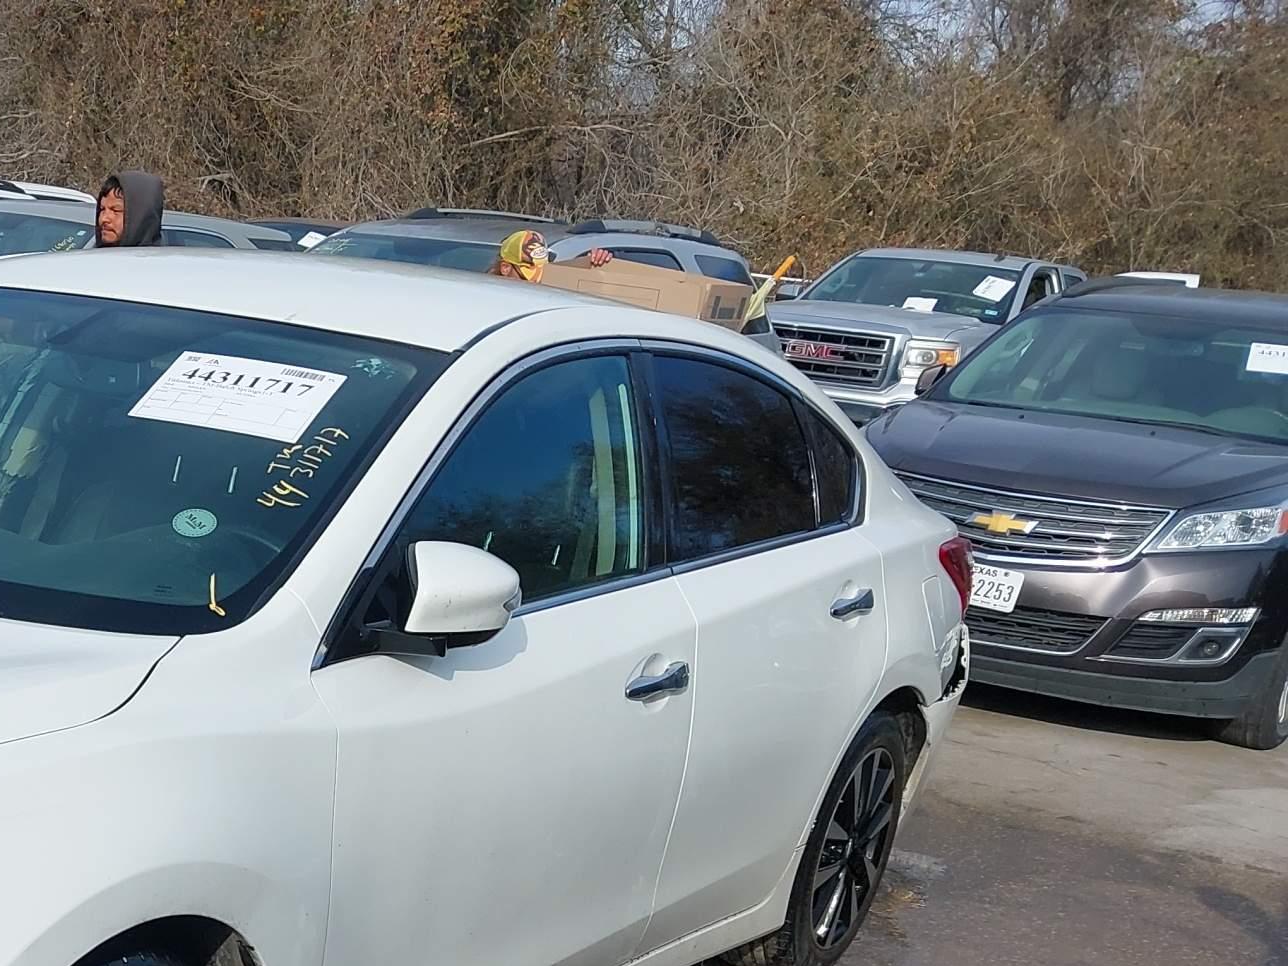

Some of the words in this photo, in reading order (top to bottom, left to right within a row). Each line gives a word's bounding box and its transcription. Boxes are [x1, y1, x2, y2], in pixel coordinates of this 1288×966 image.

[786, 341, 846, 360] GMC
[182, 368, 314, 396] 44311717
[972, 565, 998, 577] EXAS
[972, 579, 1015, 603] 2253
